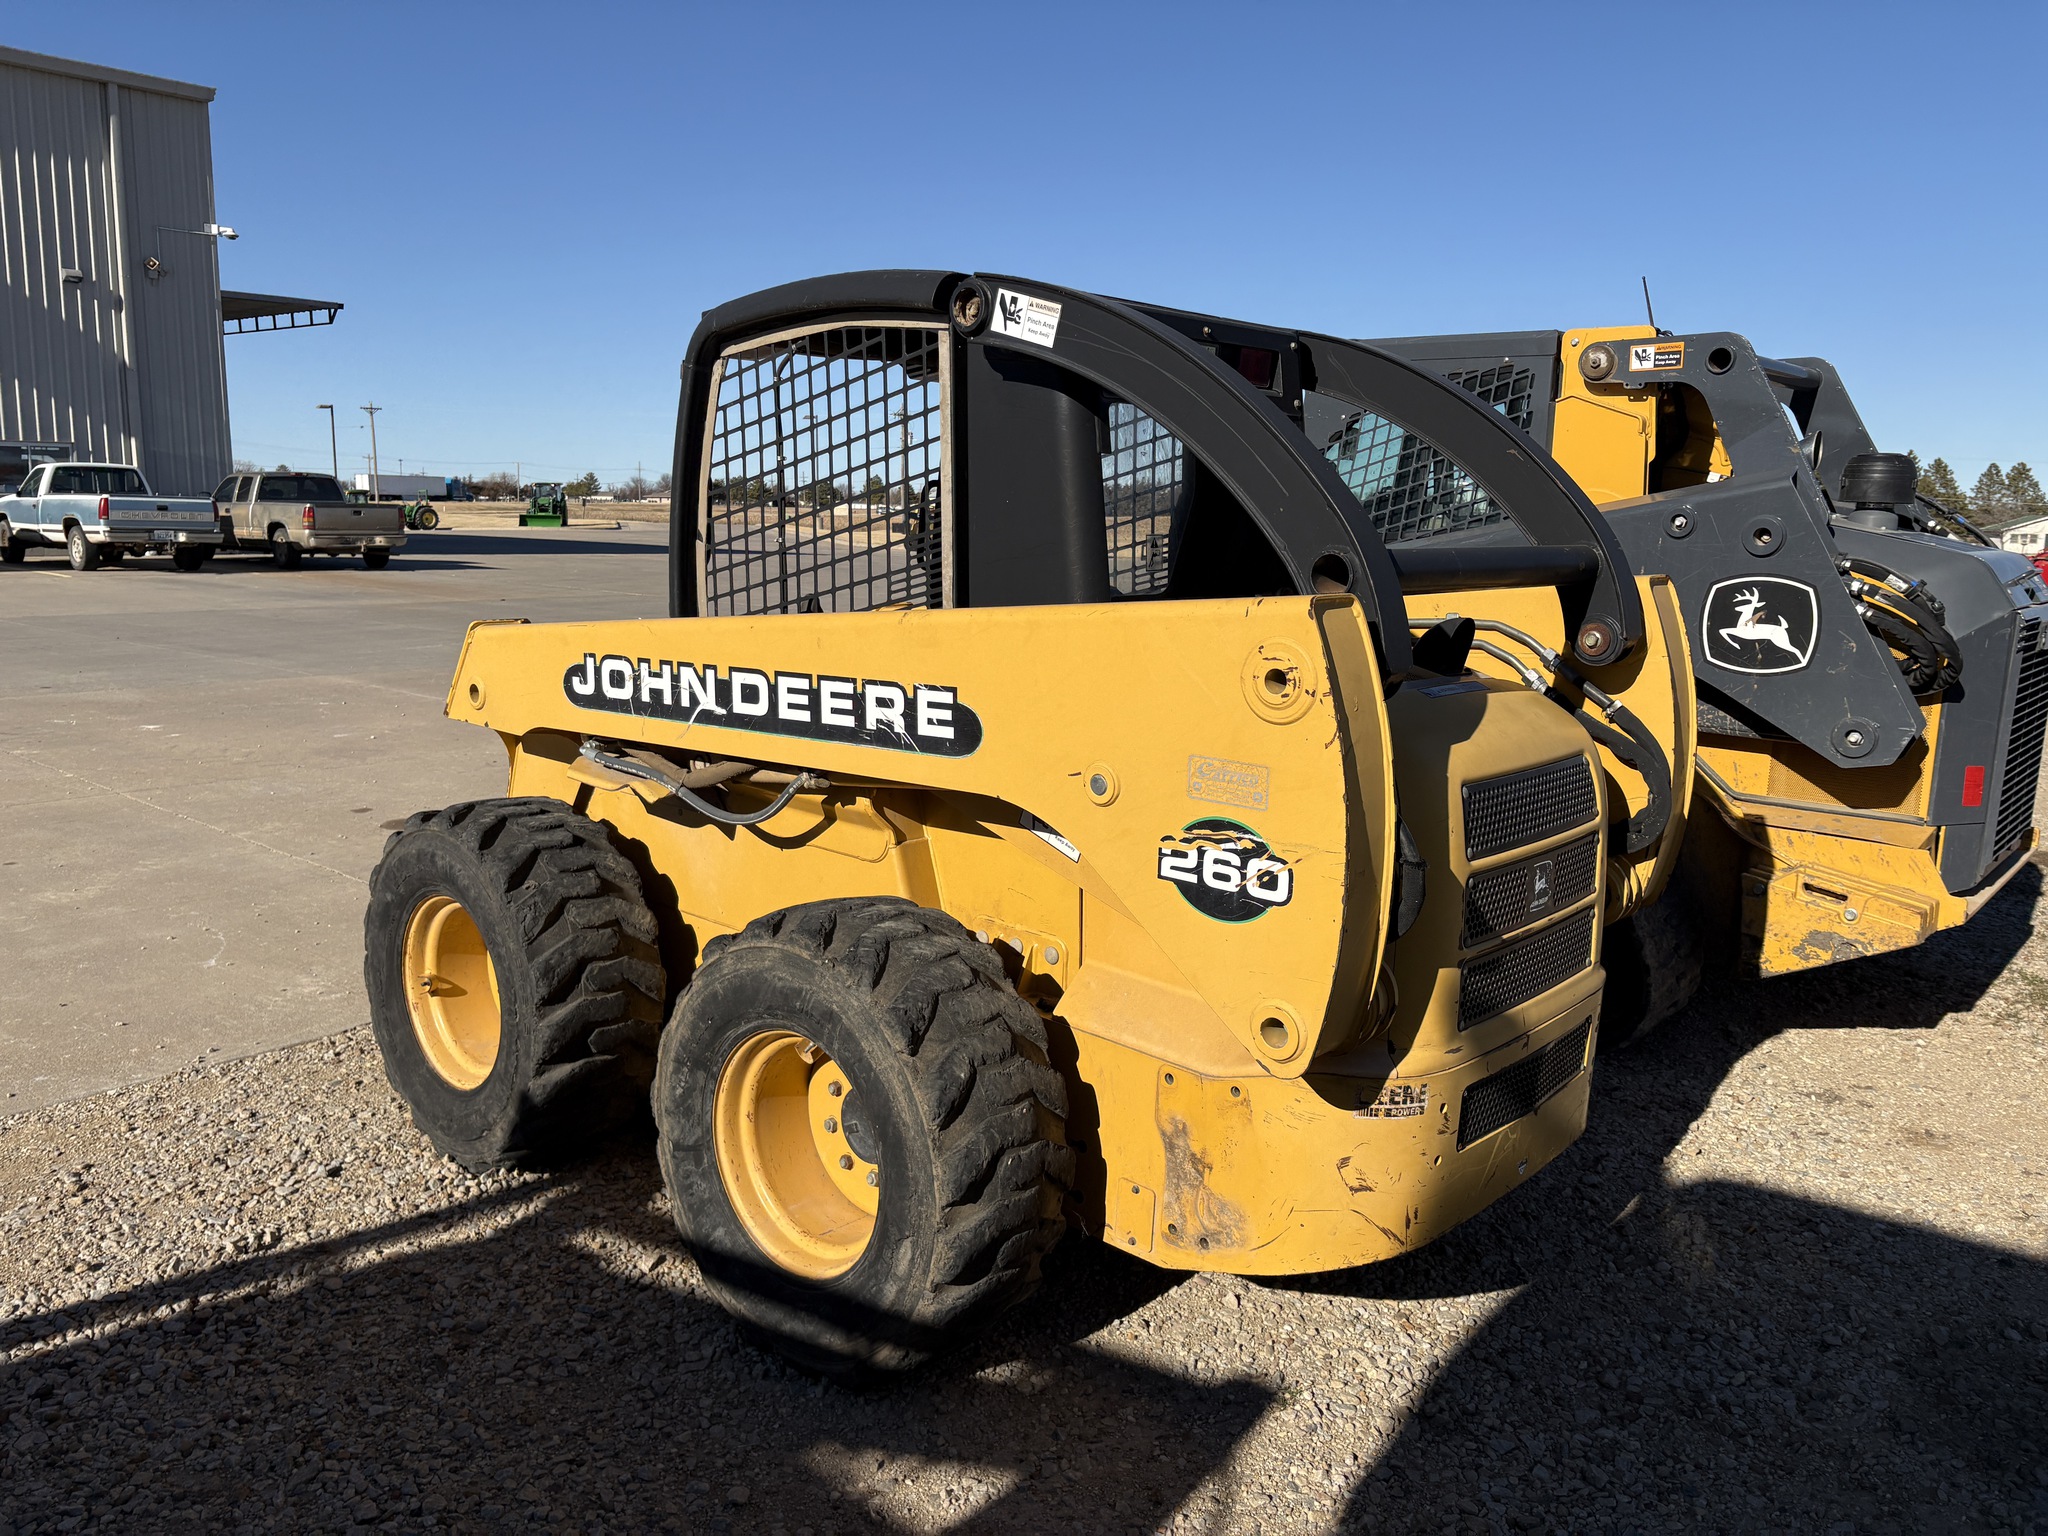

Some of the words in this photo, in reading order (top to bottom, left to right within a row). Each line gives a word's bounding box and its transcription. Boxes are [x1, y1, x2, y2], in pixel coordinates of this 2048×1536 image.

[1035, 302, 1060, 314] WARNING
[1027, 317, 1042, 326] Pinch
[1042, 321, 1055, 330] Area
[119, 511, 205, 520] CHEVROLET
[571, 656, 717, 708] JOHN
[731, 671, 956, 740] DEERE
[1160, 842, 1290, 903] 260
[1390, 1107, 1422, 1117] POWER
